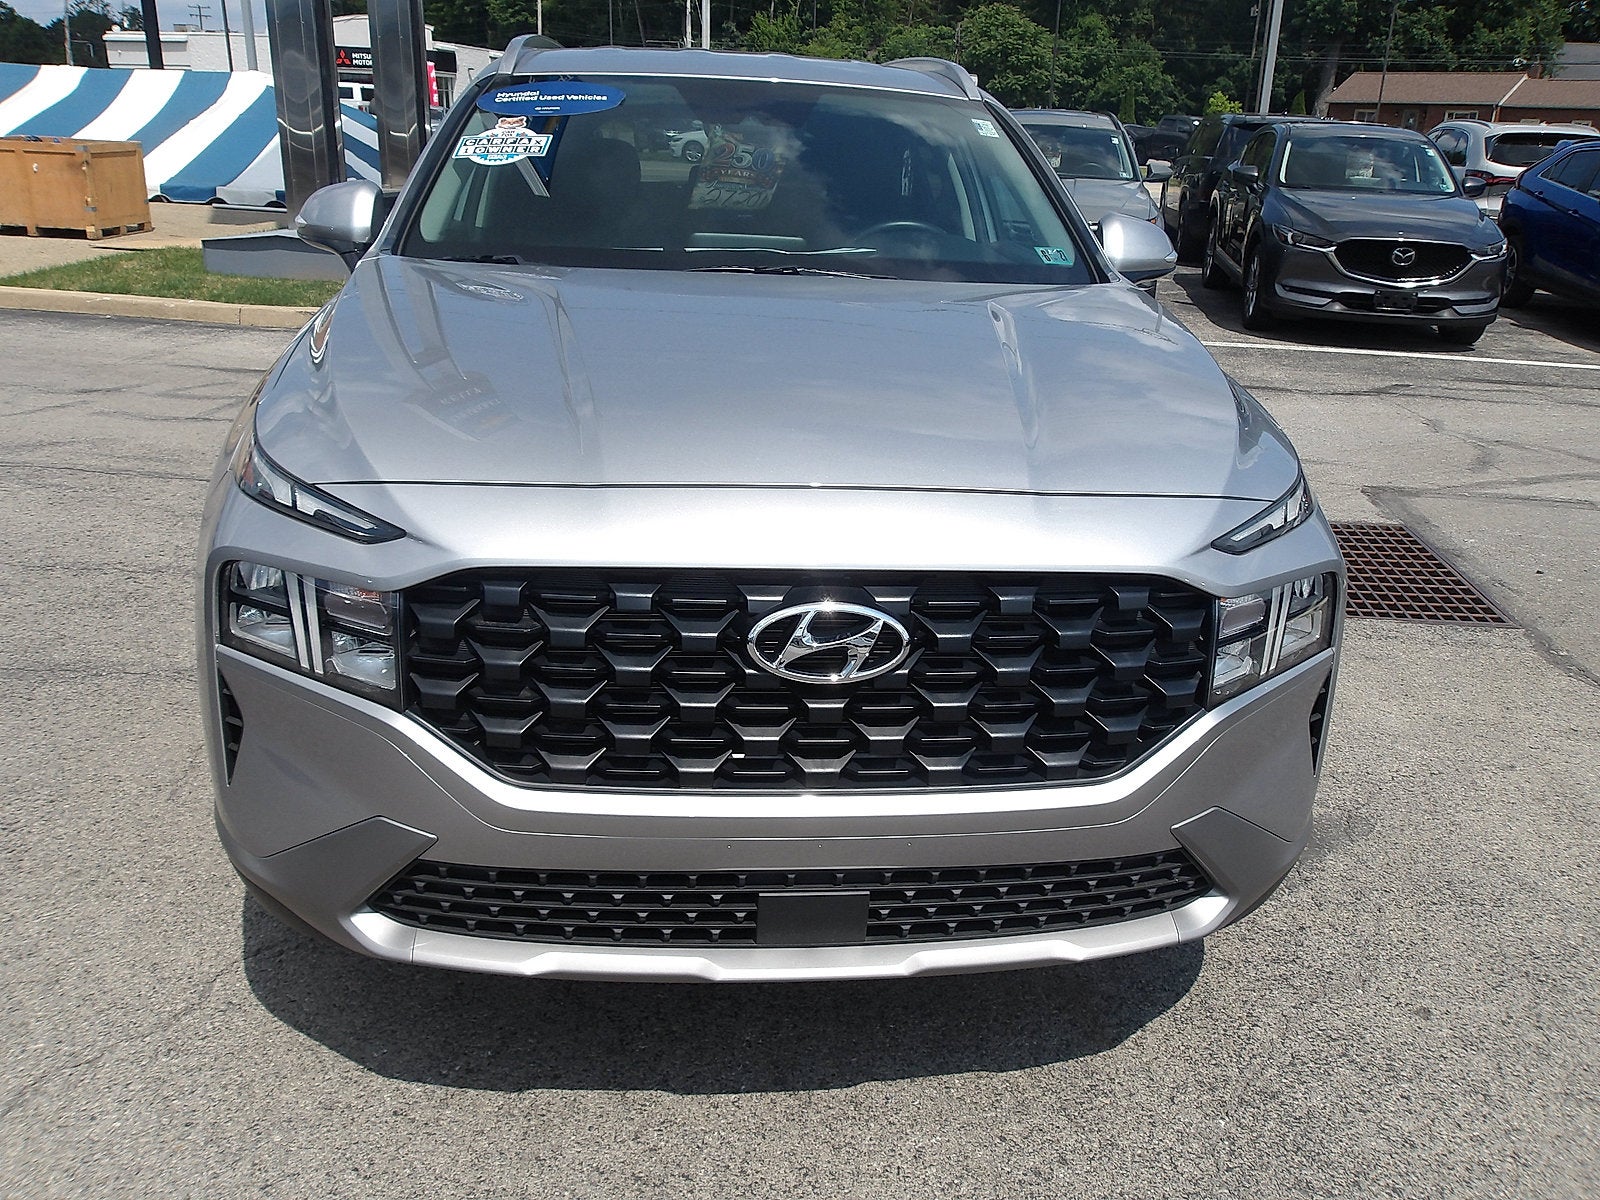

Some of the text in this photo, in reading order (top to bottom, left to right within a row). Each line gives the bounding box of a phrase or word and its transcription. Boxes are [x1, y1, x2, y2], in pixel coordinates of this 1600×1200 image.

[464, 138, 543, 147] CARFAX
[474, 146, 542, 154] OWNER
[711, 143, 775, 171] 250
